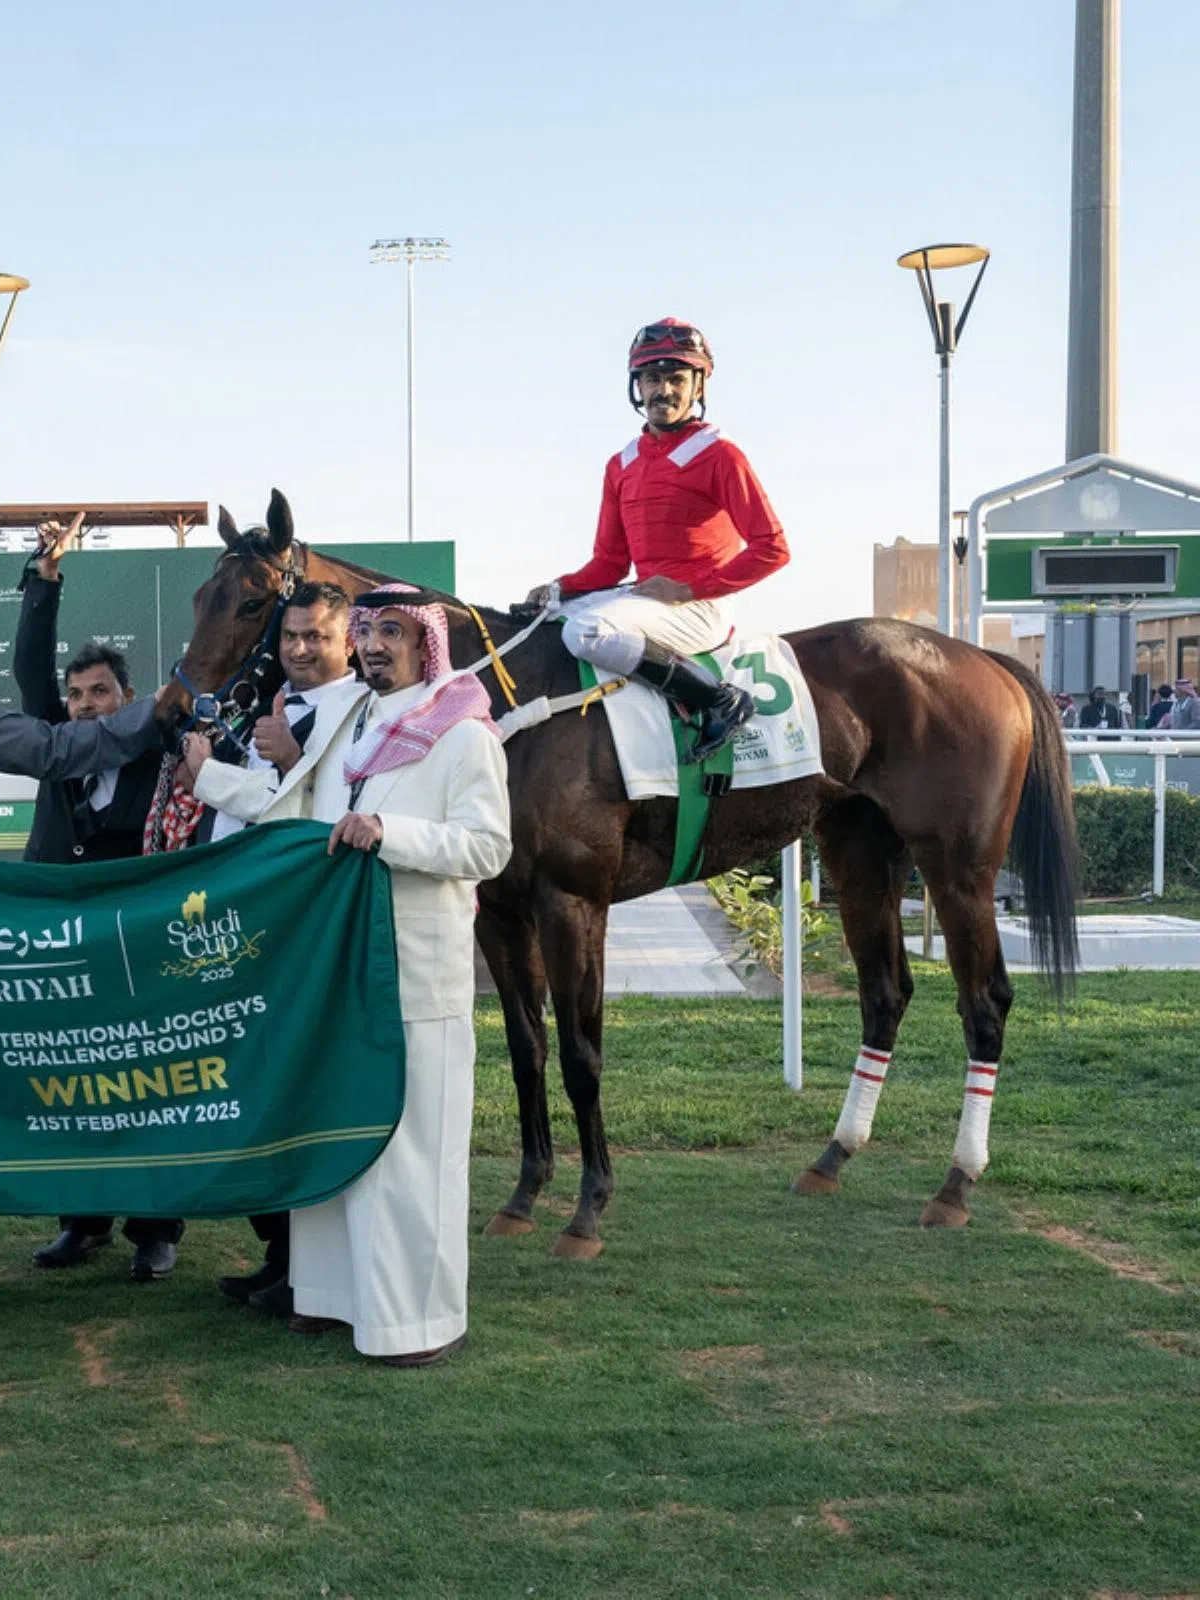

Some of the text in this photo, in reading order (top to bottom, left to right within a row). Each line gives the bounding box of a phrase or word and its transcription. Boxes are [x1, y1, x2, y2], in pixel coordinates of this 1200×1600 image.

[732, 652, 794, 716] 3
[167, 907, 242, 946] Saudi
[182, 932, 239, 960] Cup
[200, 966, 235, 983] 2025
[158, 994, 267, 1034] JOCKEYS
[2, 1020, 246, 1067] CHALLENGE ROUND 3
[28, 1056, 229, 1107] WINNER
[26, 1099, 241, 1132] 21ST FEBRUARY 2025
